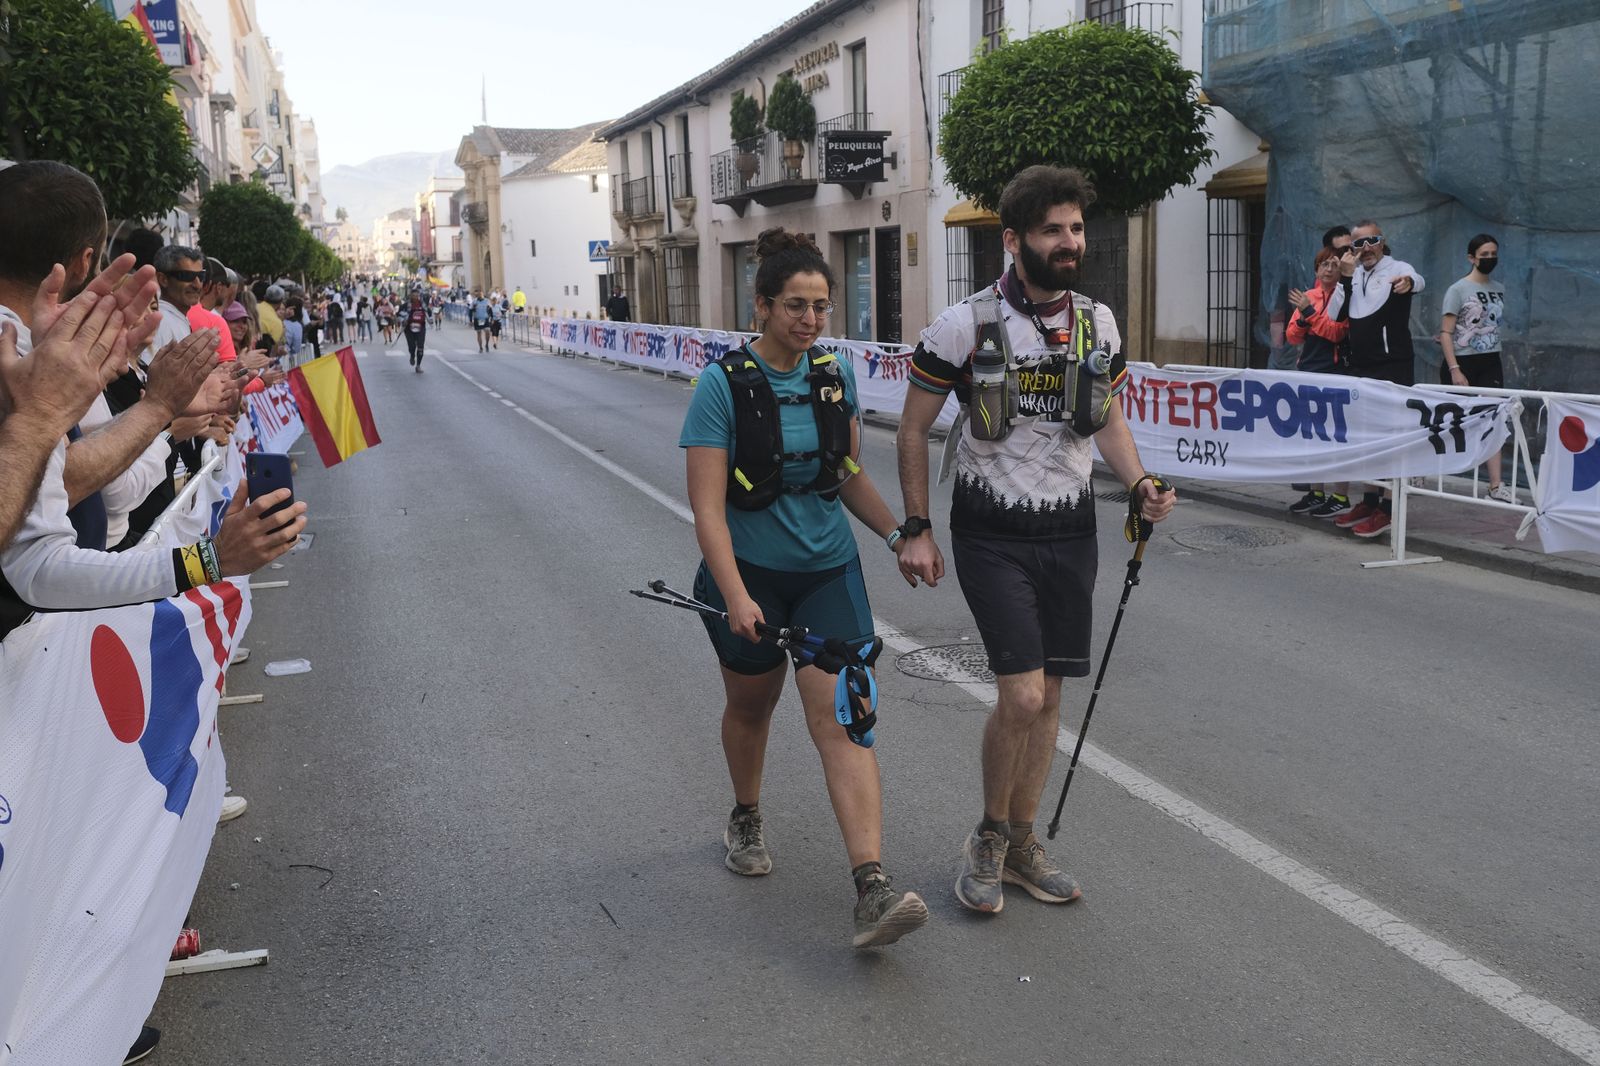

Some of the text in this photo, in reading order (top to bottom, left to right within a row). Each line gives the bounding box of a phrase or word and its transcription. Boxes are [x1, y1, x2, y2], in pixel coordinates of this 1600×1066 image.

[148, 19, 175, 31] KING
[828, 142, 881, 151] PELUQUERIA
[1176, 437, 1229, 467] CARY
